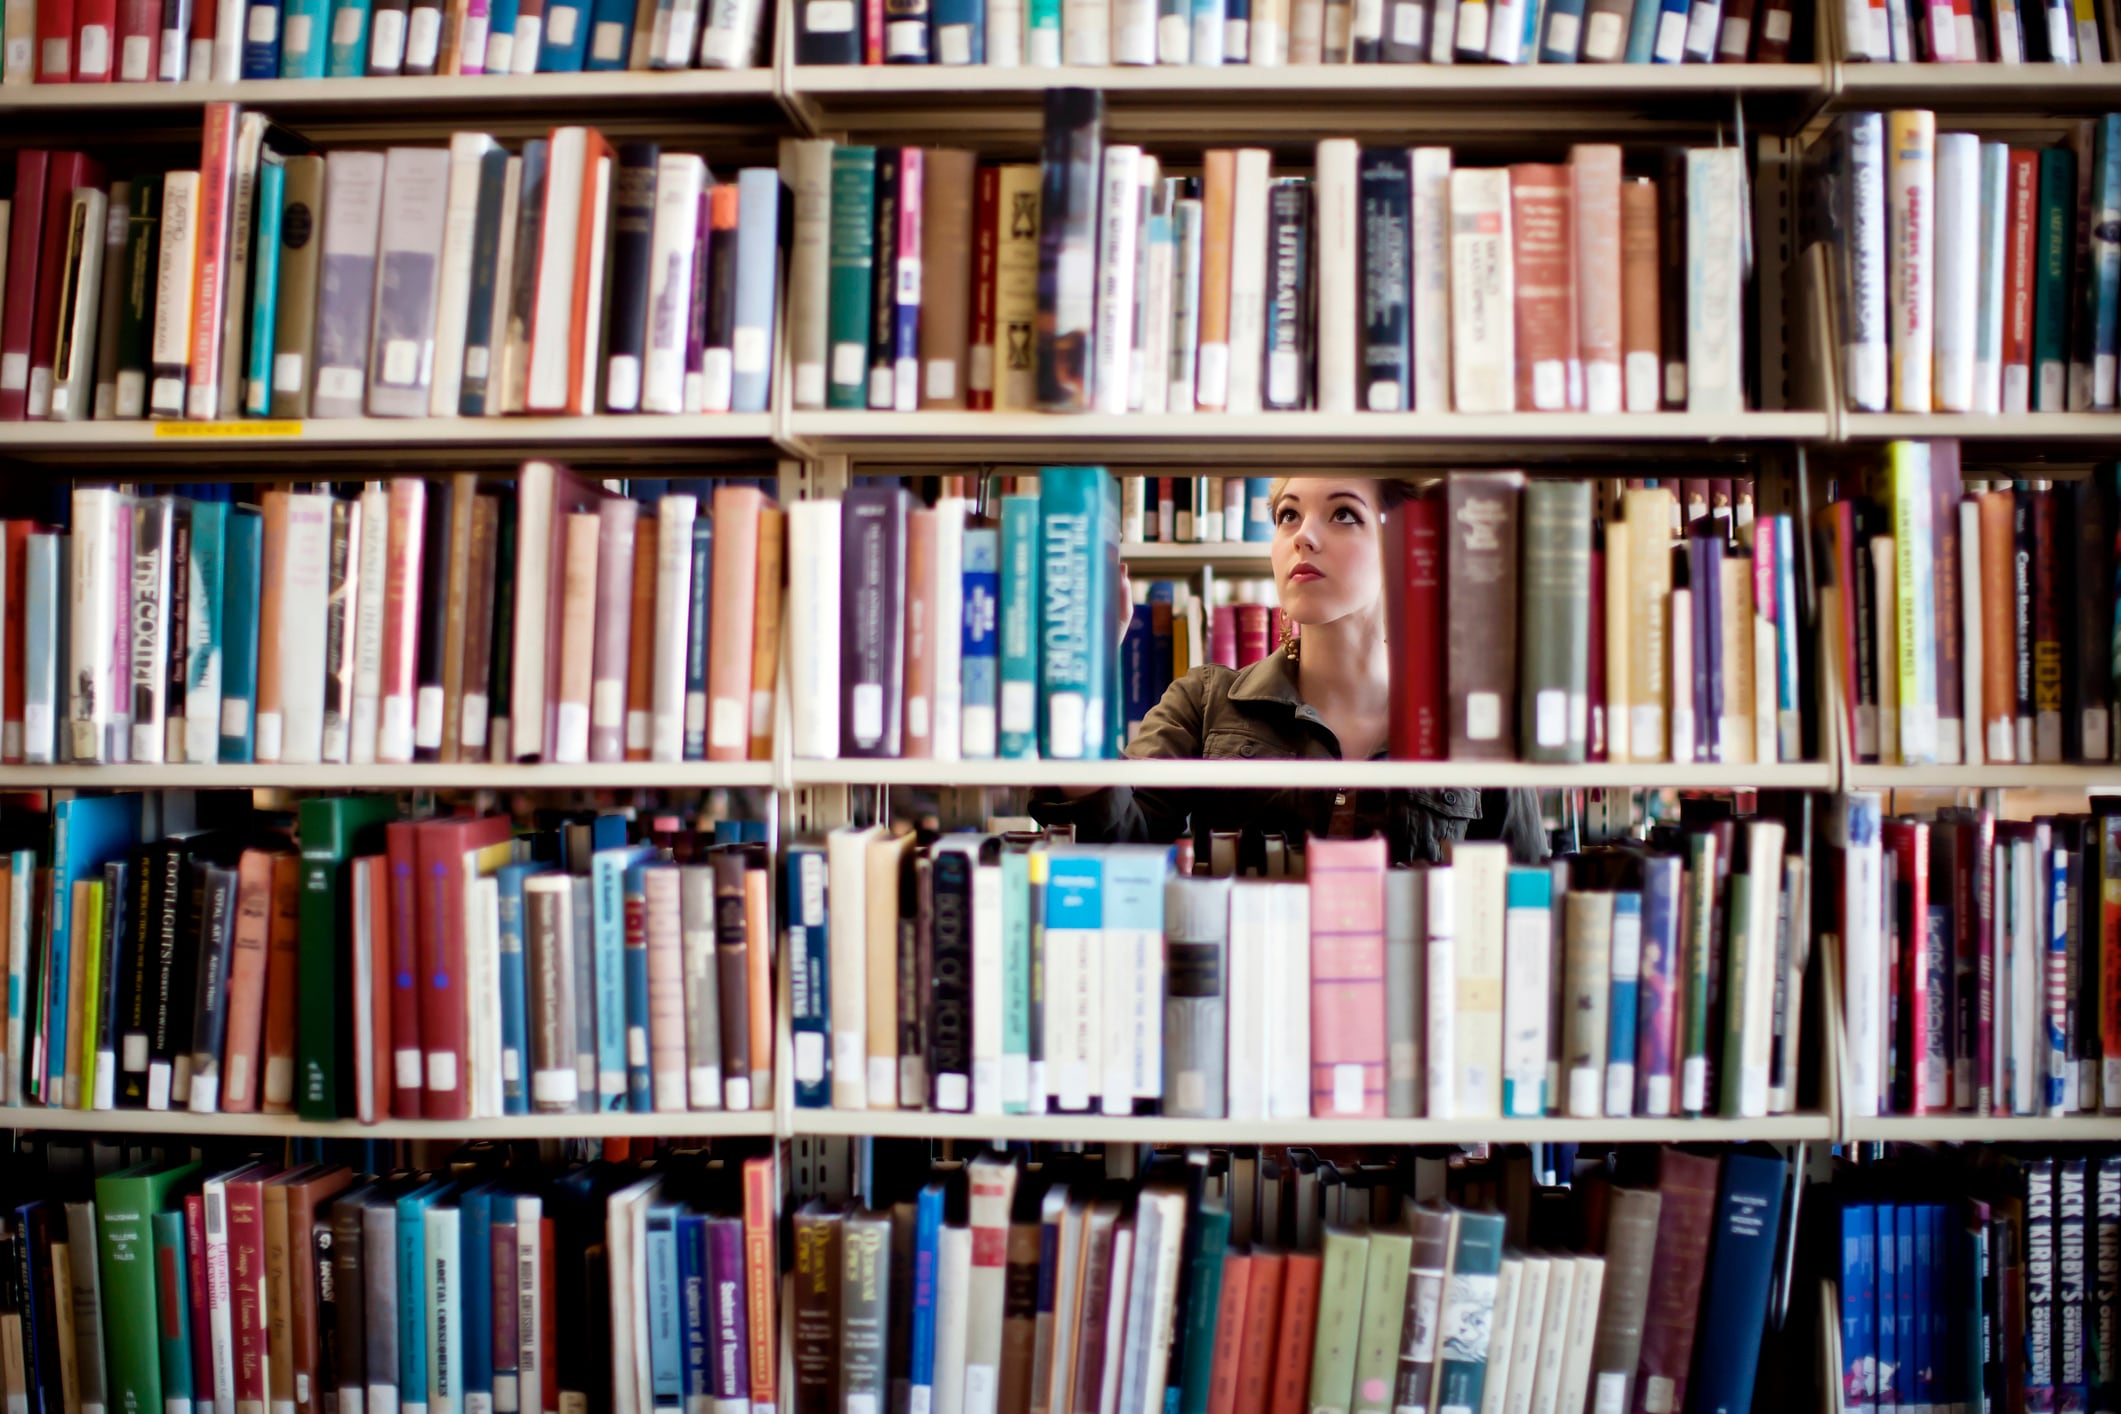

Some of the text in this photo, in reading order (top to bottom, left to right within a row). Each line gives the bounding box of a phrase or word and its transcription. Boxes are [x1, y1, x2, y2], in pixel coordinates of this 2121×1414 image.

[2018, 162, 2031, 187] The
[172, 187, 188, 242] TEATRO
[2018, 190, 2029, 220] Best
[2016, 223, 2028, 288] American
[2015, 291, 2027, 341] Comics
[361, 508, 380, 674] JAPANESE THEATRE
[1901, 499, 1916, 678] DANGEROUS DRAWINGS
[2015, 551, 2030, 593] Comic
[1045, 514, 1074, 686] LITERATURE
[2017, 596, 2029, 635] Books
[119, 623, 129, 666] THEATRE
[2018, 652, 2031, 701] History
[137, 880, 150, 942] PRODUCTION
[211, 888, 227, 919] TOTAL
[156, 852, 182, 1050] FOOTLIGHTS! ROBERT HEWISON
[210, 924, 223, 944] ART
[17, 1223, 26, 1239] ECO
[2028, 1172, 2052, 1303] JACK KIRBY'S
[2060, 1171, 2084, 1302] JACK KIRBY'S
[2097, 1171, 2121, 1301] JACK KIRBY'S
[20, 1261, 30, 1289] WALKS
[205, 1253, 219, 1311] Viewpoint
[216, 1241, 230, 1303] Characters
[236, 1283, 251, 1294] of
[318, 1260, 338, 1304] FANTASY
[435, 1257, 449, 1398] MORTAL CONSEQUENCES
[685, 1276, 702, 1329] Explorers
[755, 1267, 767, 1342] STEAMPUNK
[242, 1335, 253, 1347] in
[688, 1331, 705, 1344] of
[689, 1346, 705, 1365] the
[720, 1280, 738, 1395] Seekers of Tomorrow
[757, 1345, 768, 1380] BIBLE
[2031, 1305, 2045, 1385] OMNIBUS
[2043, 1305, 2052, 1384] FOURTH WORLD
[2062, 1305, 2075, 1384] OMNIBUS
[2073, 1305, 2083, 1384] FOURTH WORLD
